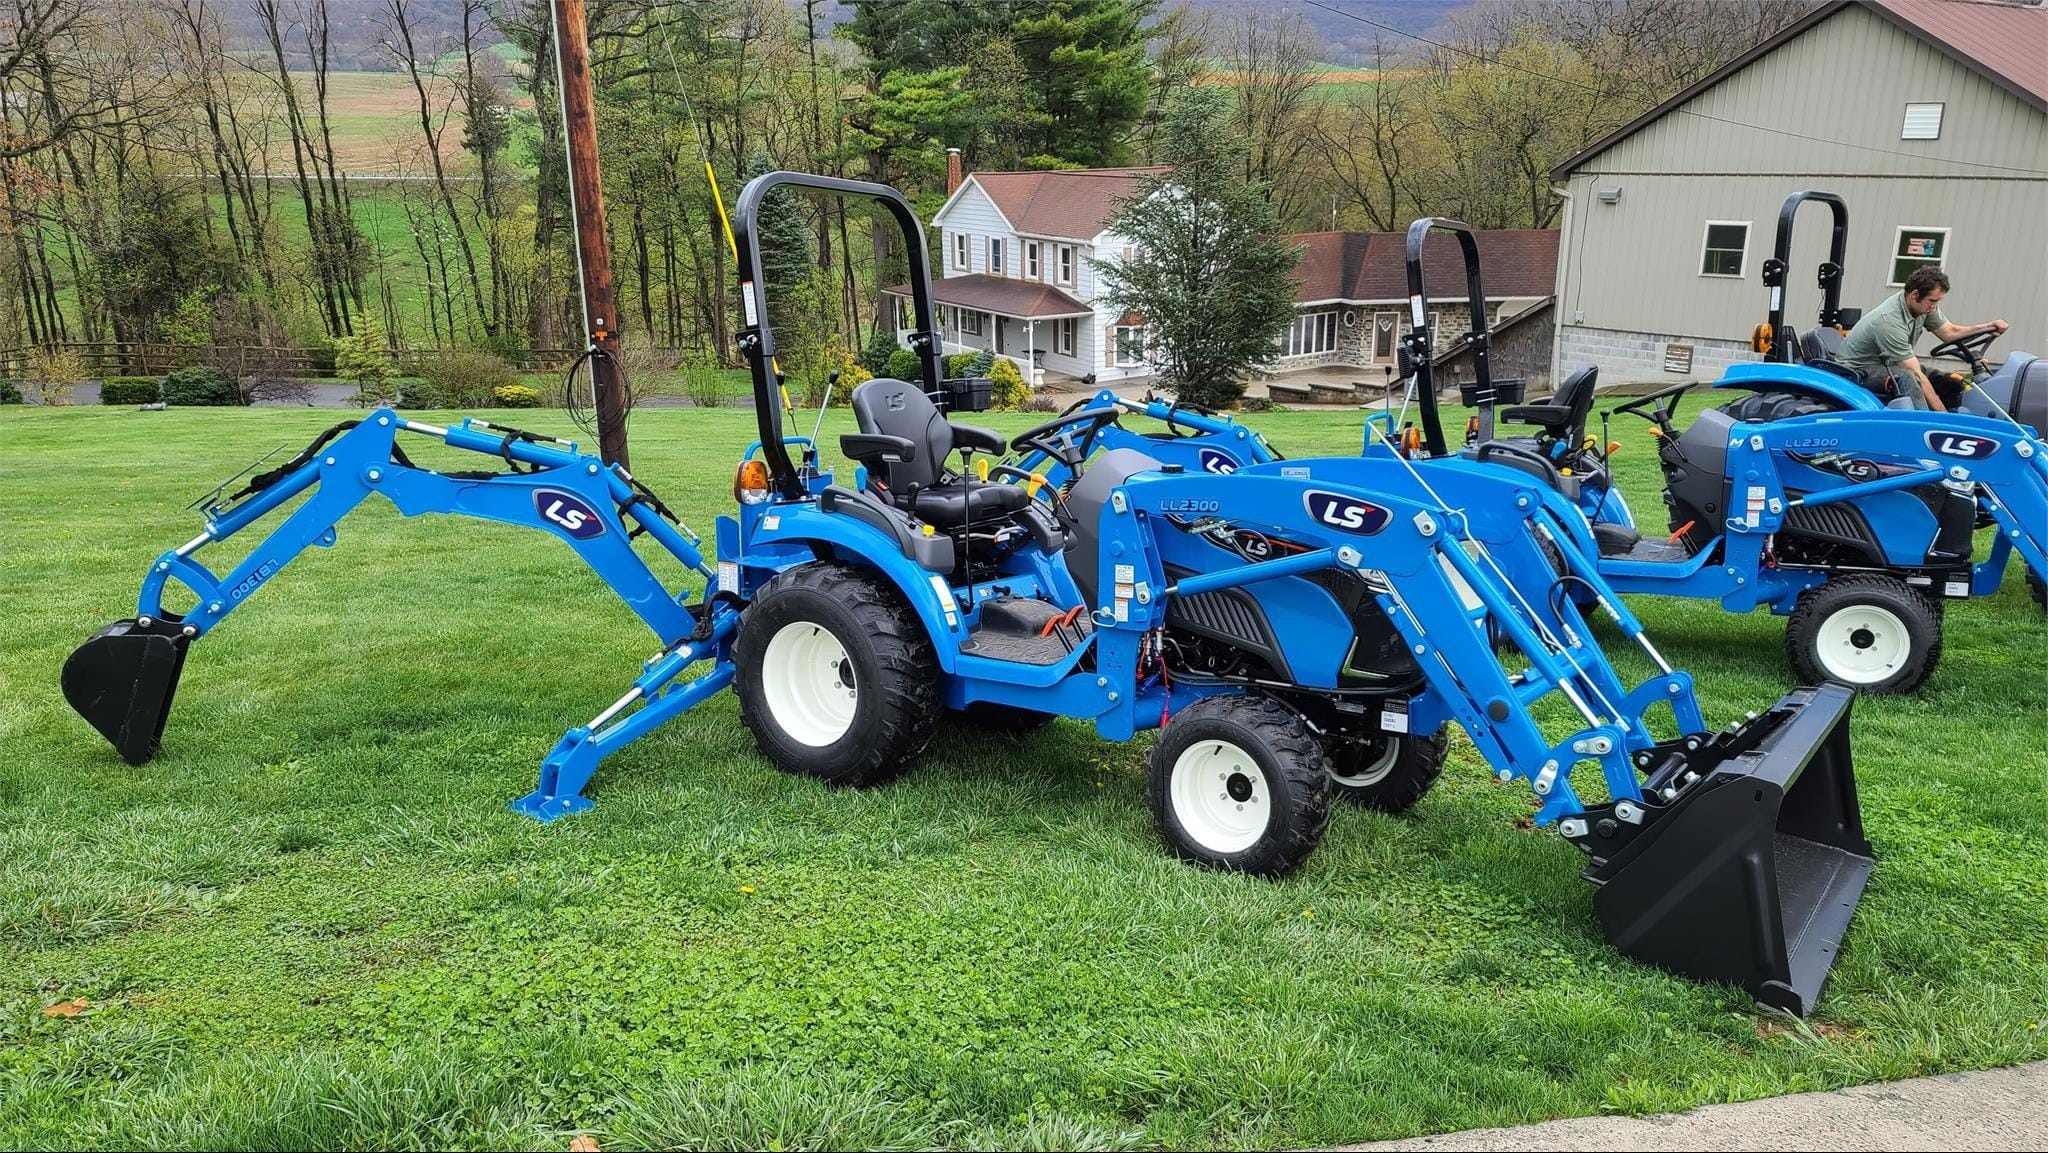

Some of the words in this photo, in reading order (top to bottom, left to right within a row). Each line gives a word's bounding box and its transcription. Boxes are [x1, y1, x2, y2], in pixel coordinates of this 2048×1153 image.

[885, 392, 906, 412] LS
[1785, 438, 1839, 448] LL2300
[1940, 437, 1979, 456] LS
[1847, 465, 1869, 476] LS
[545, 500, 588, 530] LS
[1160, 499, 1220, 512] LL2300
[1323, 501, 1366, 528] LS
[1245, 539, 1268, 556] LS
[231, 558, 279, 600] LB1300
